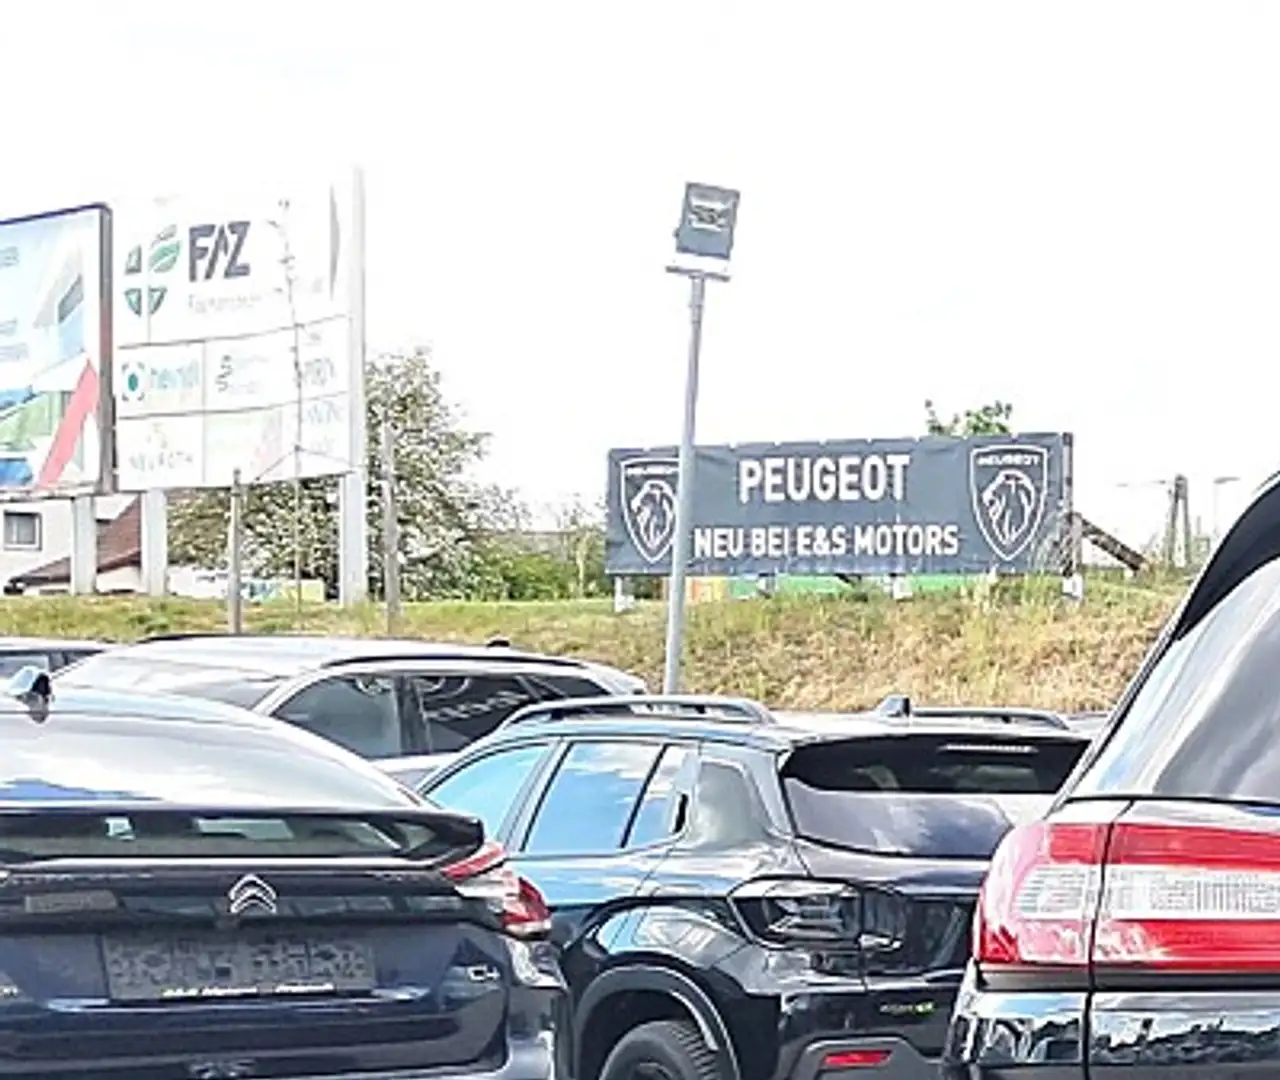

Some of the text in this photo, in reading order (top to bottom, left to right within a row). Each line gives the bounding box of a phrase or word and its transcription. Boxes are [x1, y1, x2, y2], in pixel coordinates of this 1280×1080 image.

[188, 221, 251, 282] FAZ
[739, 453, 912, 503] PEUGEOT
[694, 523, 959, 559] NEU BEI E&S MOTORS
